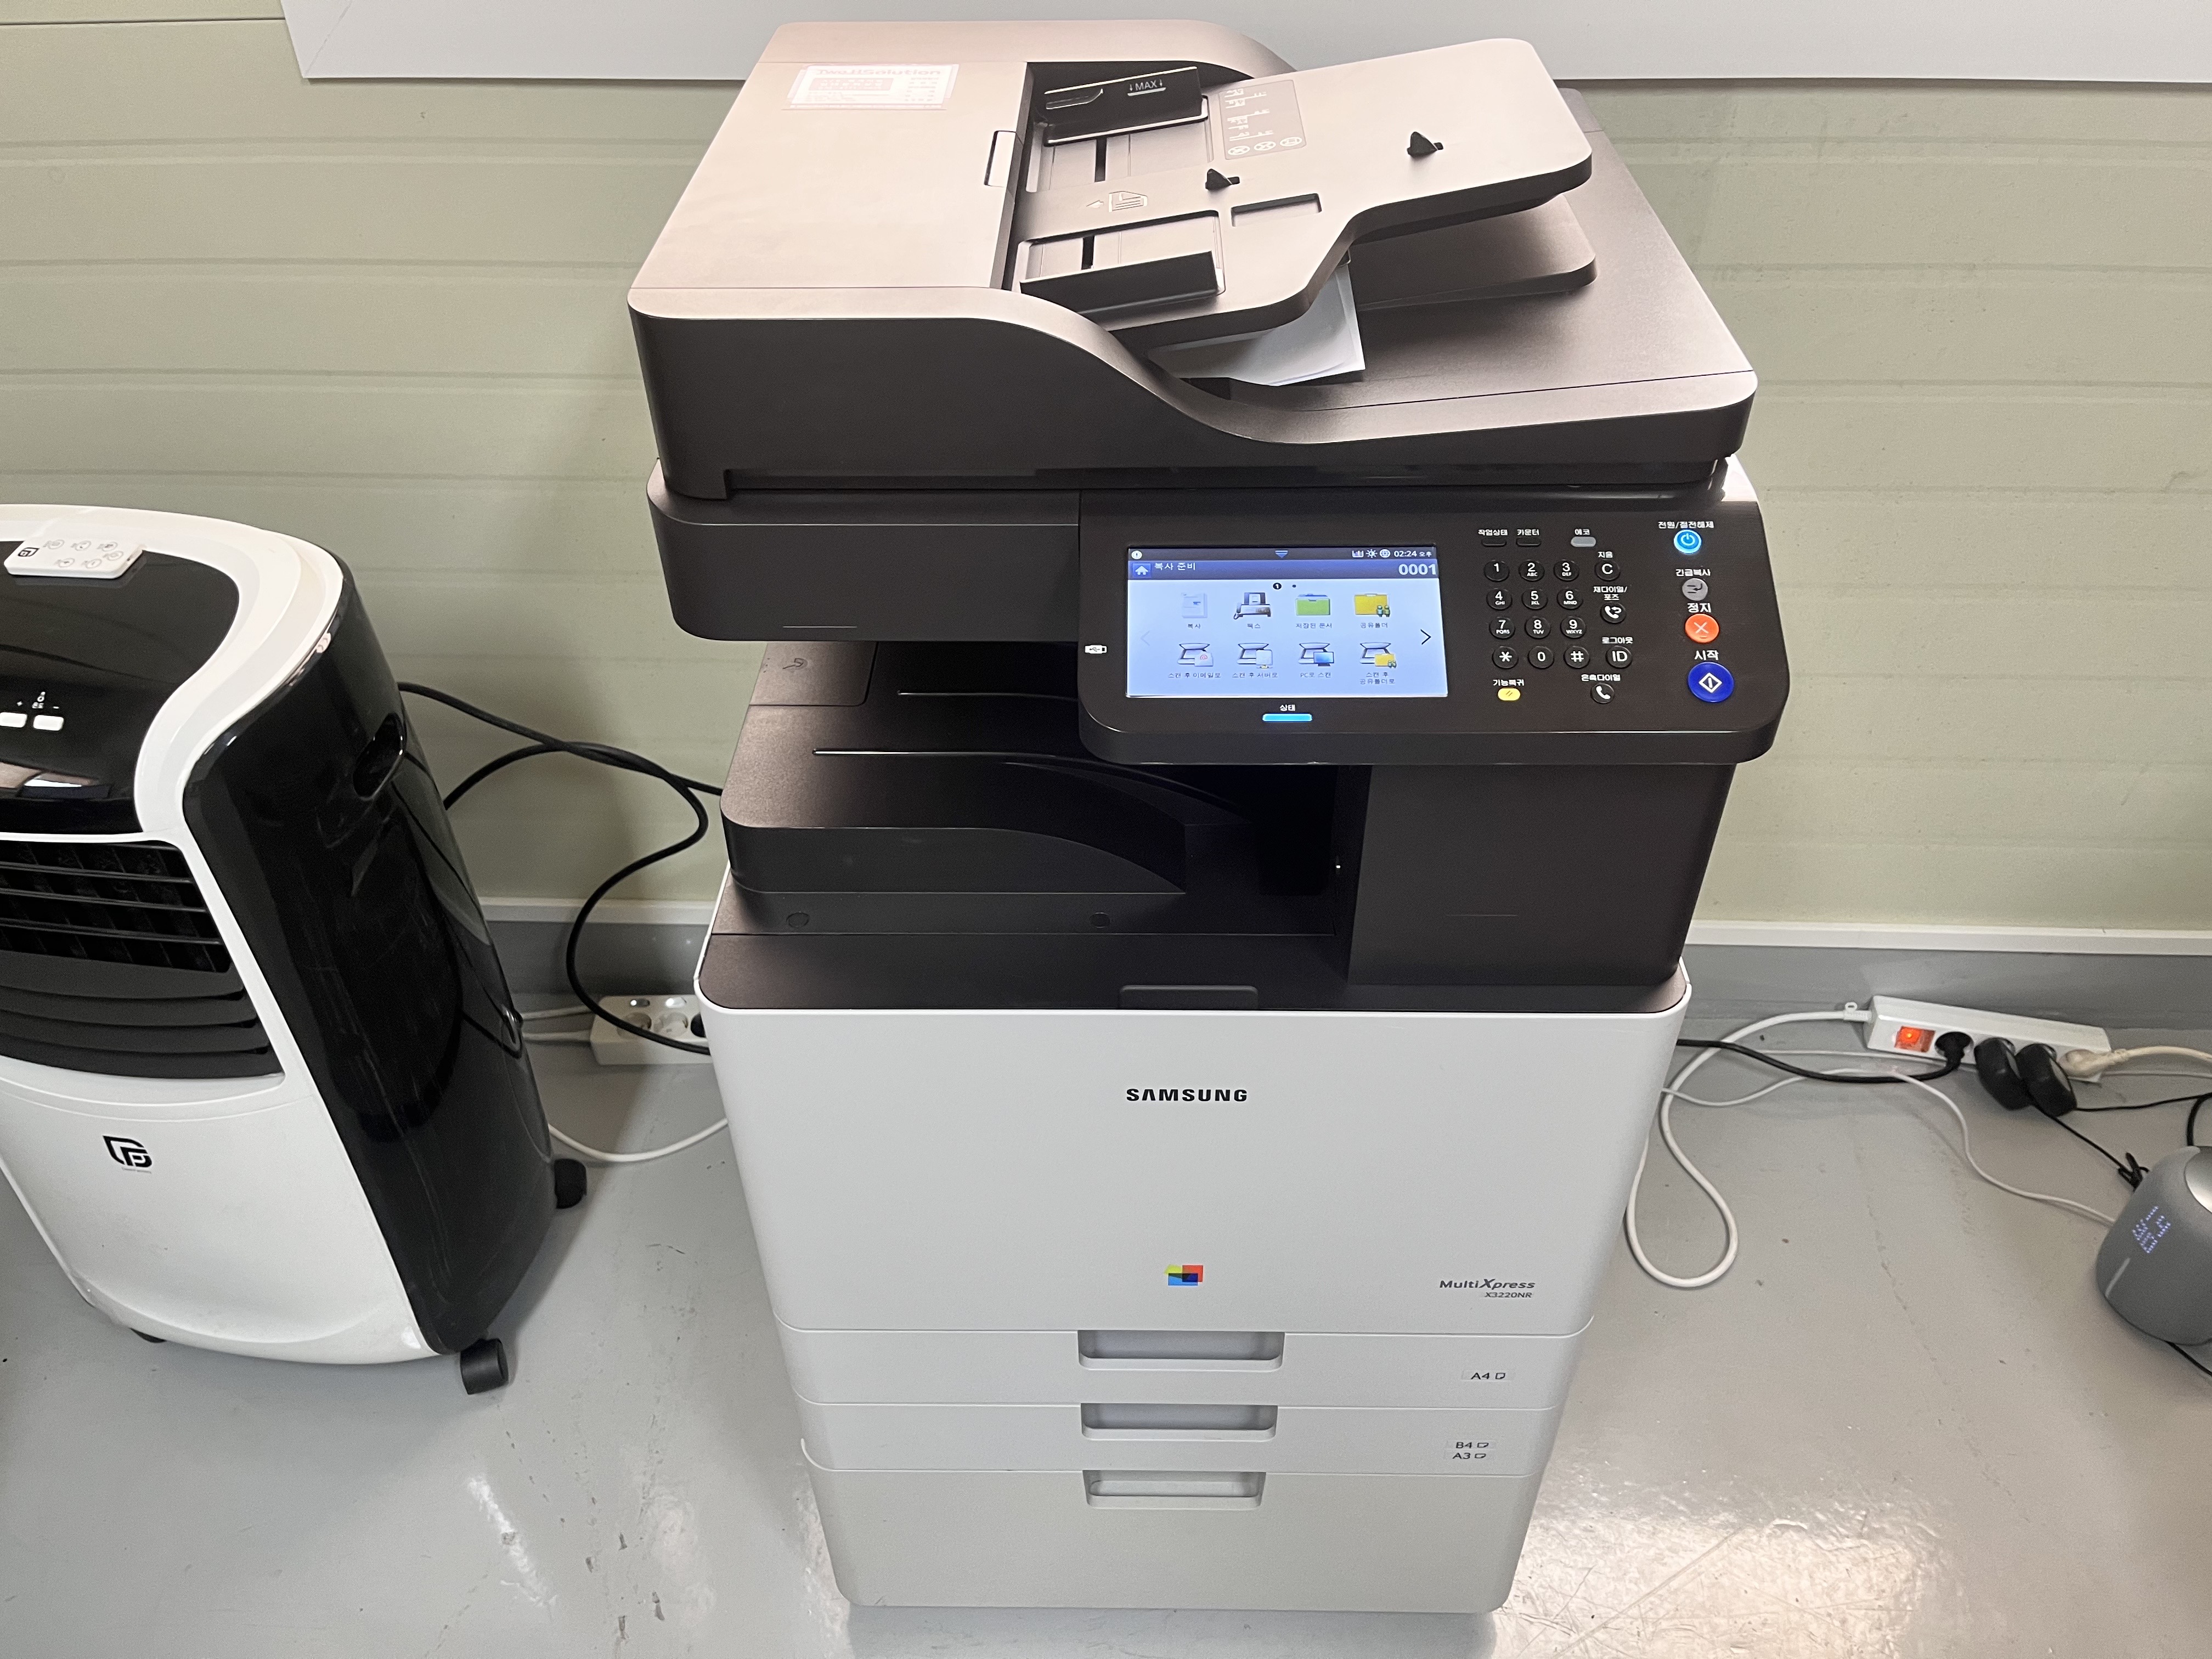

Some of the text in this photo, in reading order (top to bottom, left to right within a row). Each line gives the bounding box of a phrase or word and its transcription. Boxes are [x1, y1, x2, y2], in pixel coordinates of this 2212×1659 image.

[1135, 80, 1158, 91] MAX
[1154, 562, 1196, 571] 복사 준비
[1398, 563, 1437, 575] 0001
[1493, 563, 1499, 572] 1
[1527, 562, 1536, 572] 2
[1562, 562, 1571, 572] 3
[1601, 563, 1613, 575] C
[1495, 591, 1503, 601] 4
[1531, 590, 1539, 600] 5
[1565, 590, 1574, 600] 6
[1687, 602, 1712, 613] 정지
[1498, 620, 1506, 629] 7
[1533, 619, 1543, 629] 8
[1569, 619, 1578, 629] 9
[1537, 651, 1547, 662] 0
[1570, 651, 1584, 662] #
[1612, 651, 1628, 662] ID
[1694, 650, 1719, 661] 시작
[1126, 1088, 1247, 1102] SAMSUNG
[1440, 1279, 1536, 1290] MultiXpress
